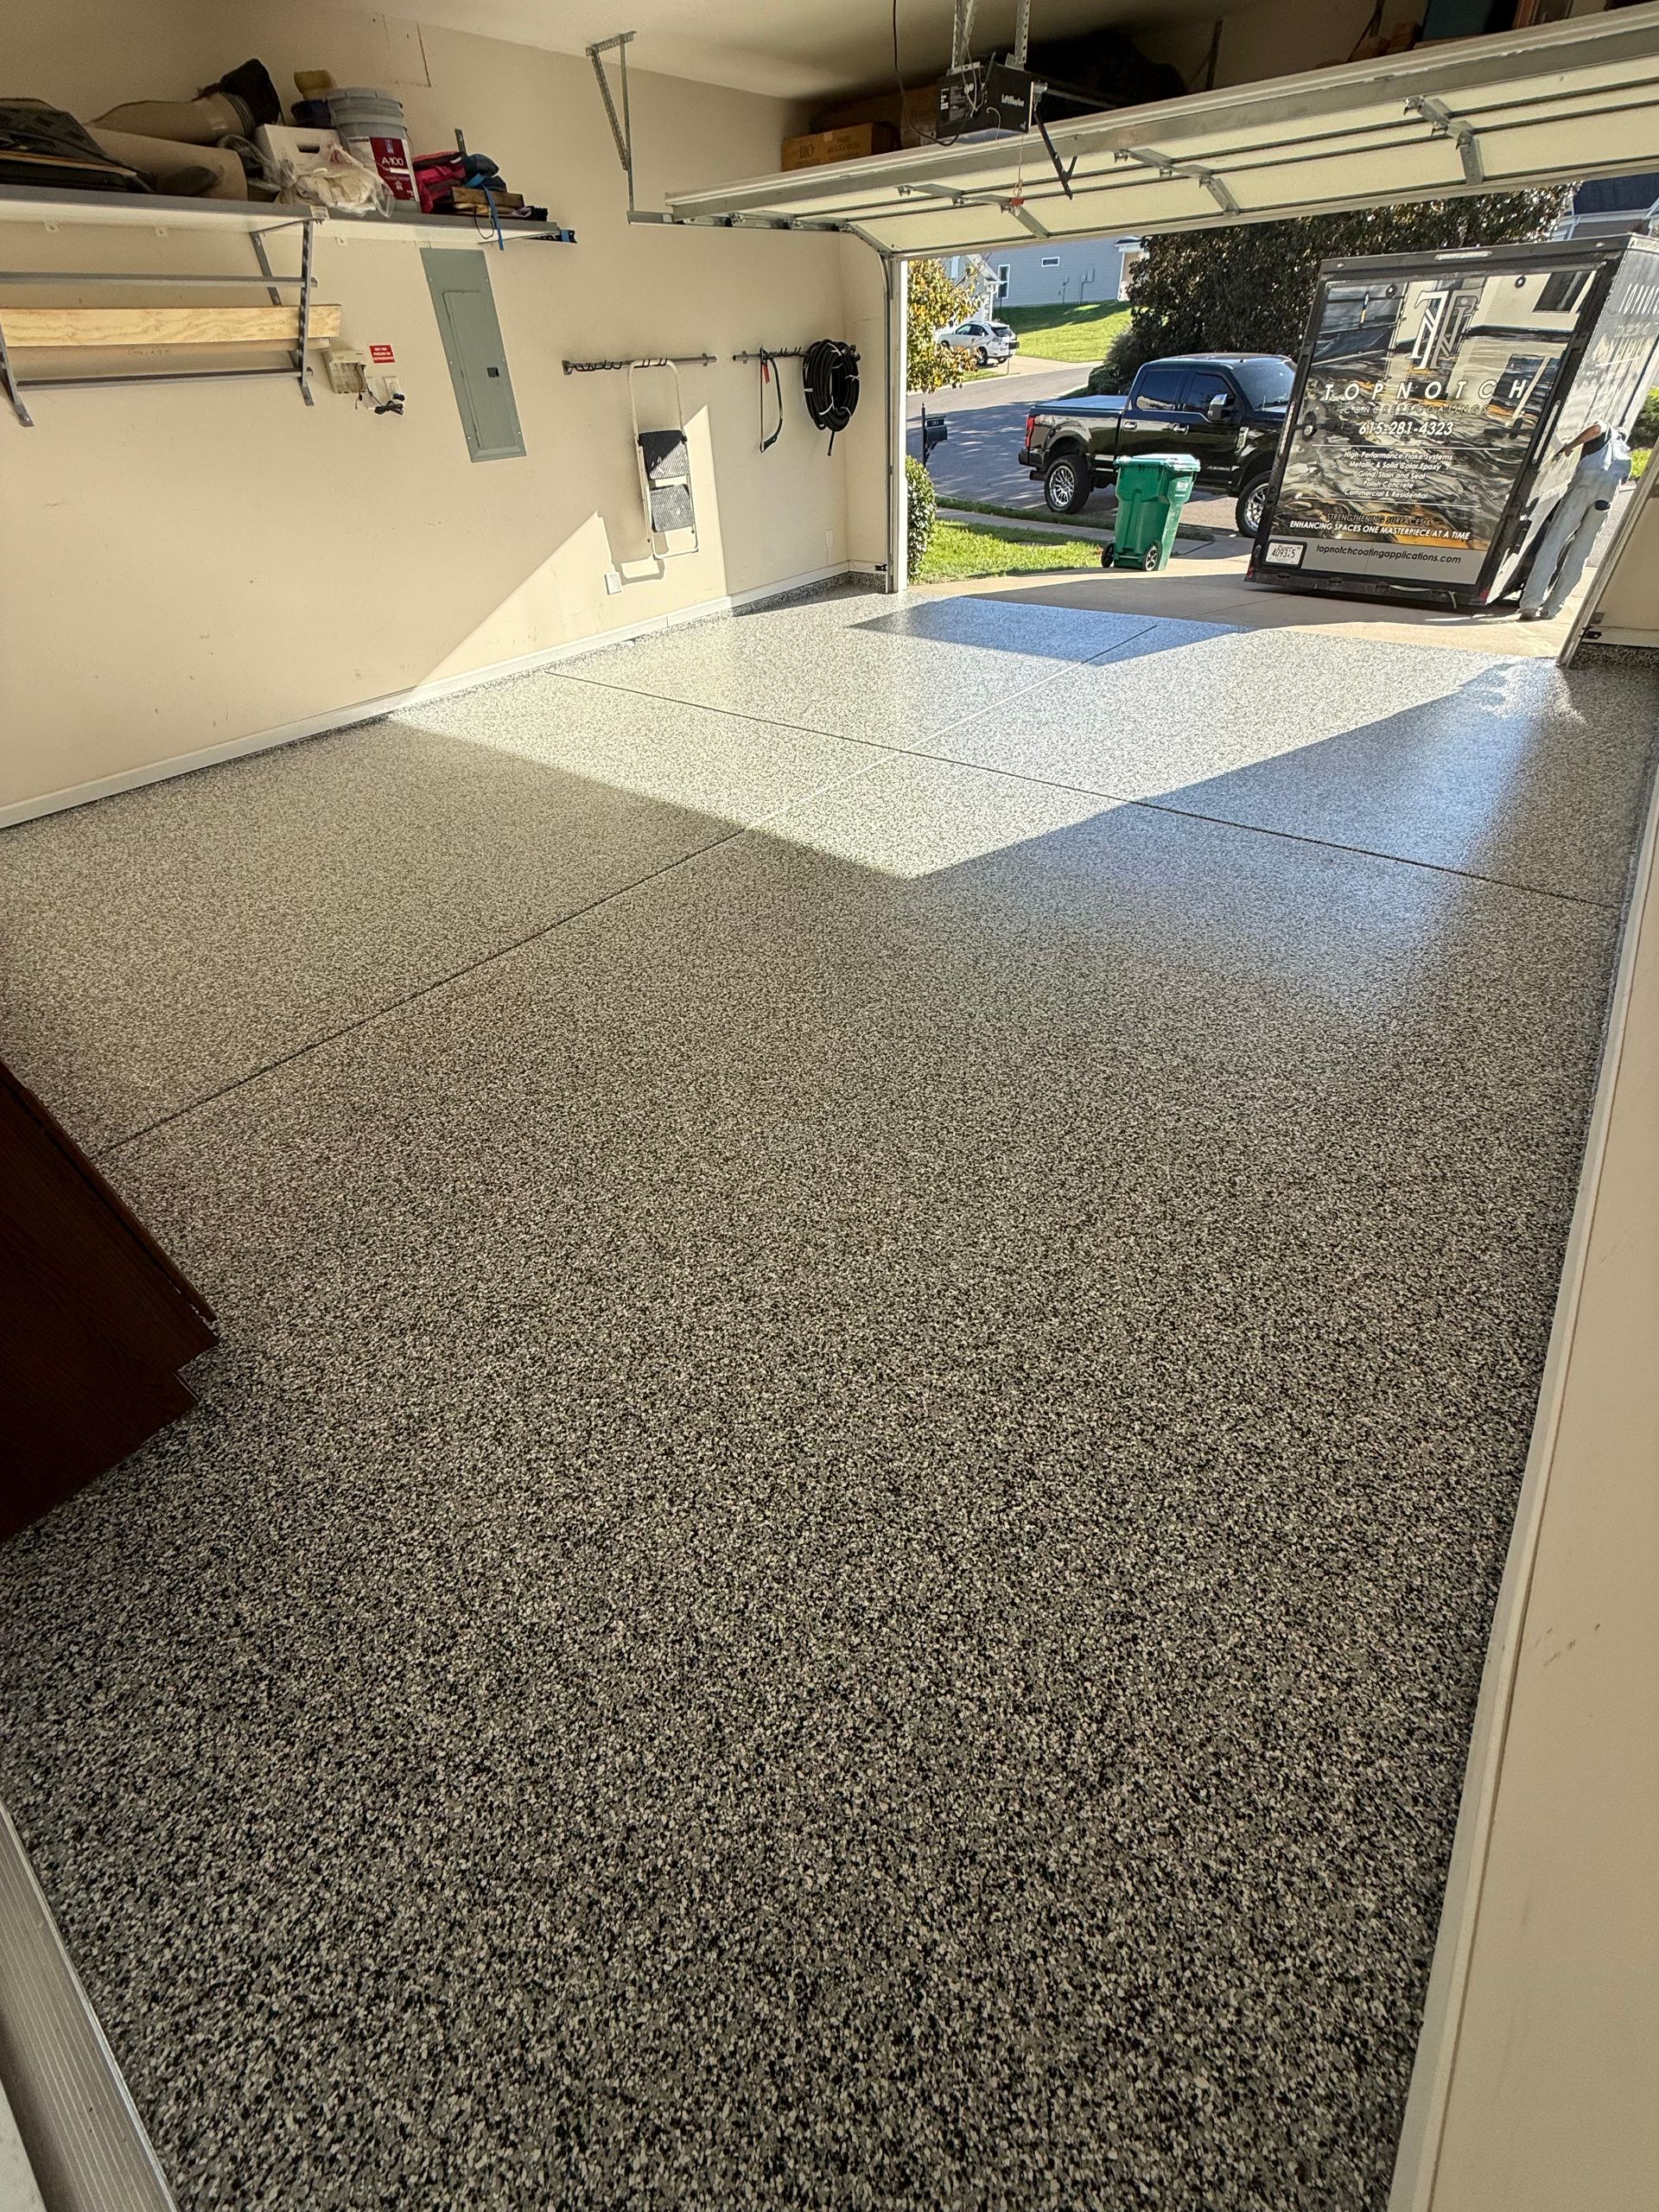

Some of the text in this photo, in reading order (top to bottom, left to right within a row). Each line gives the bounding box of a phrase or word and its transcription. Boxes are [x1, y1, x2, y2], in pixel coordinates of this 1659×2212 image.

[1344, 404, 1488, 415] CONCRETE COATINGS
[1358, 420, 1453, 435] 615-281-4323
[1344, 451, 1403, 460] High-Performance
[1424, 453, 1453, 461] Systems
[1419, 463, 1442, 472] Epoxy
[1382, 480, 1414, 489] Concrete
[1344, 488, 1384, 497] Commercial
[1391, 491, 1429, 499] Residential
[1326, 512, 1384, 524] STRENGTHENING
[1387, 516, 1424, 526] SURFACES
[1289, 520, 1333, 531] ENHANCING
[1334, 523, 1361, 533] SPACES
[1363, 524, 1380, 534] ONE
[1380, 525, 1431, 537] MASTERPIECE
[1452, 531, 1471, 540] TIME
[1316, 543, 1462, 565] topnotchcoatingapplications.com
